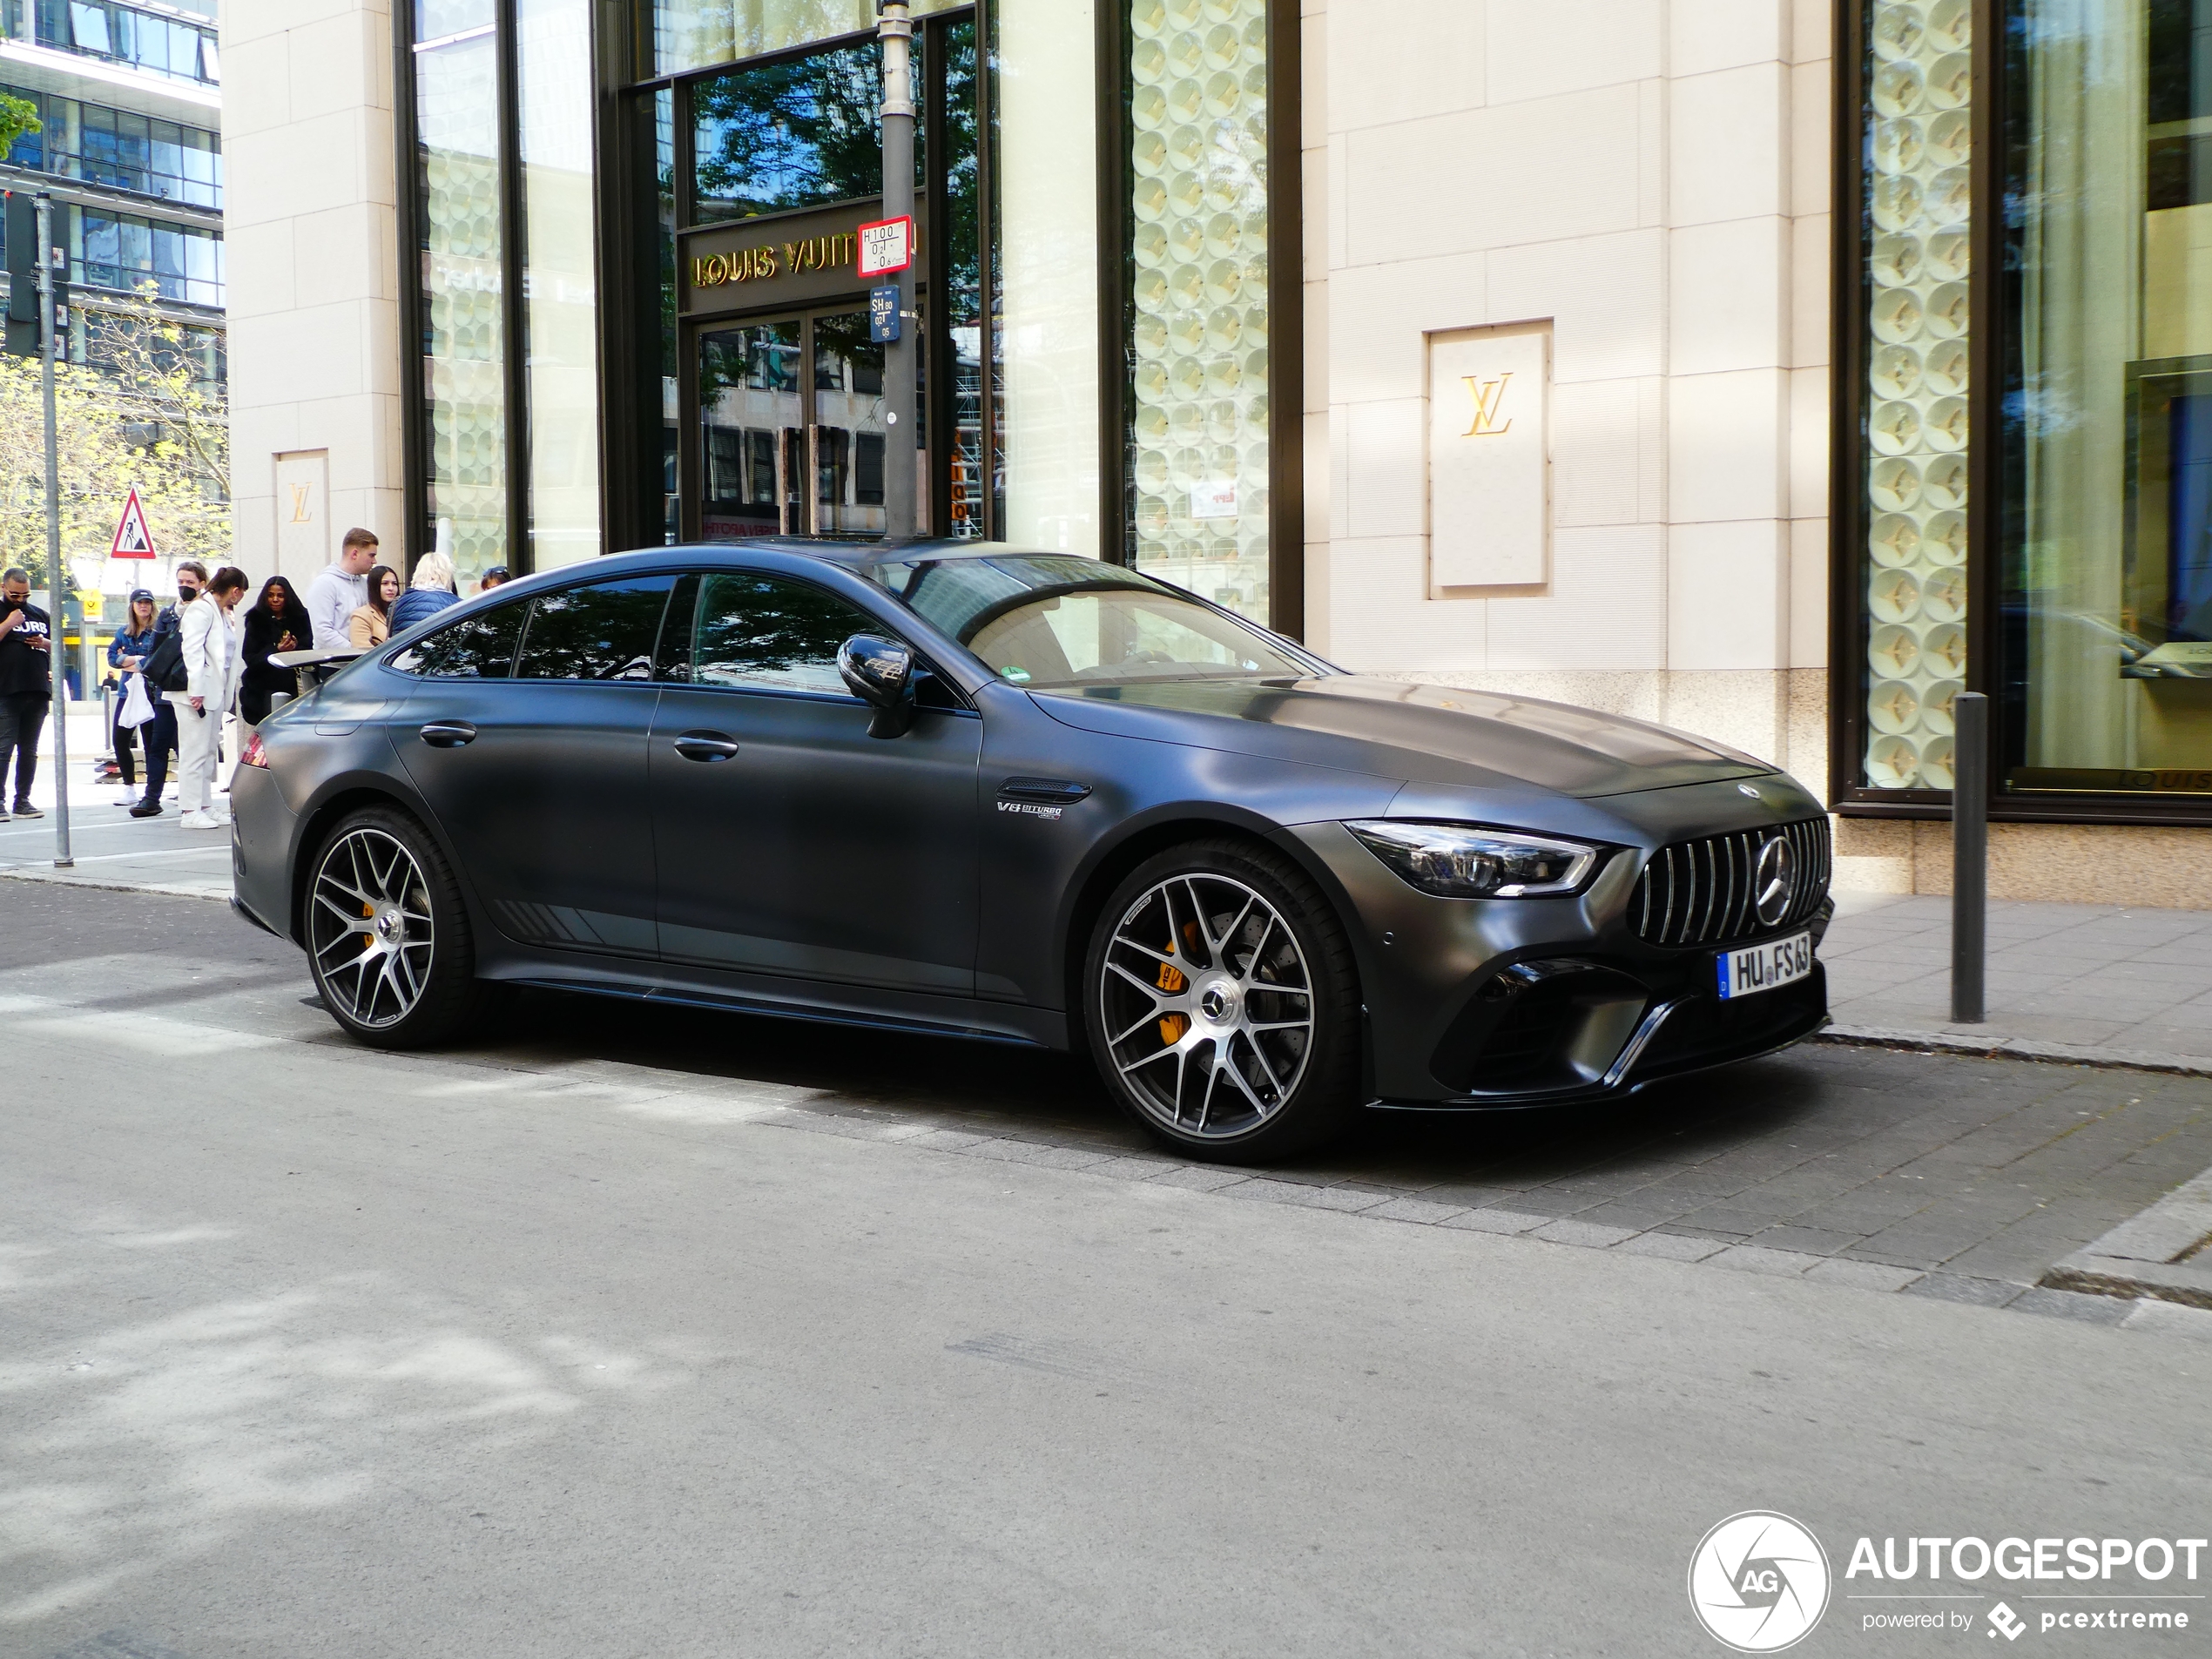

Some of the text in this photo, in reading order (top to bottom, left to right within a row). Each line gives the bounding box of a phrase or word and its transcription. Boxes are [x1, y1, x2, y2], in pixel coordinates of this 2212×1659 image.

[691, 245, 776, 287] LOUIS
[872, 298, 884, 312] SH
[1008, 666, 1019, 675] 4
[997, 801, 1062, 814] V8 BITURBO
[1737, 949, 1764, 990] HU
